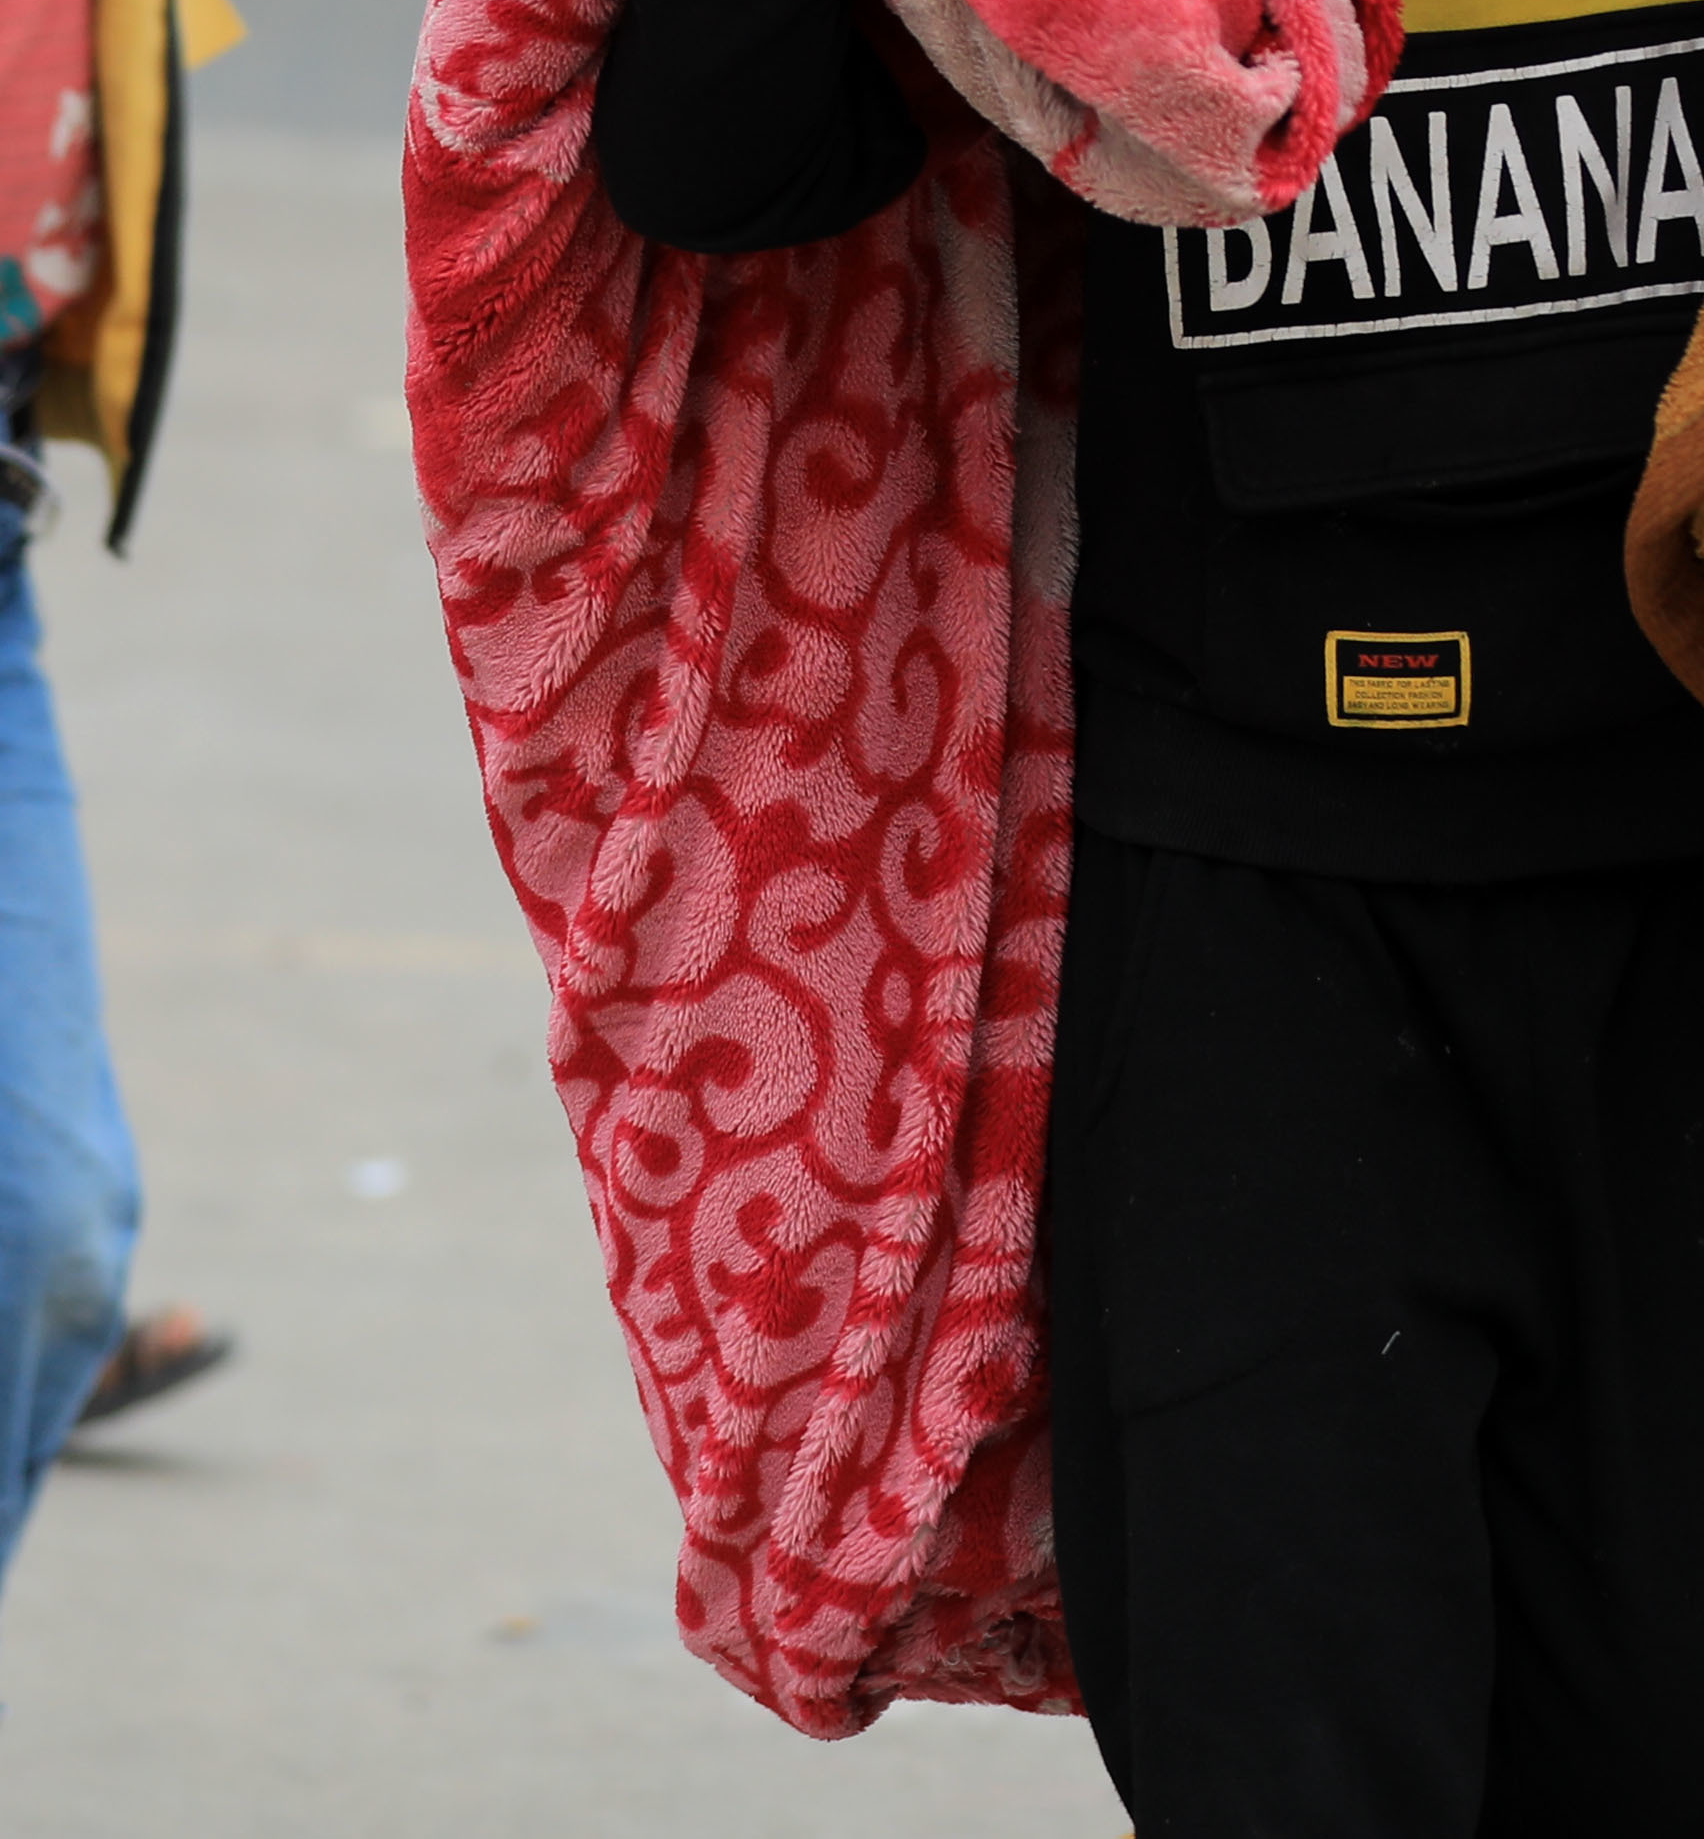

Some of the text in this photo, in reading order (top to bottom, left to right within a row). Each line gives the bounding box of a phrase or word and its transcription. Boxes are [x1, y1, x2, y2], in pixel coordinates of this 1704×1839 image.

[1358, 654, 1439, 669] NEW
[1355, 691, 1443, 699] COLLECTION FASHION
[1387, 701, 1409, 710] LONG
